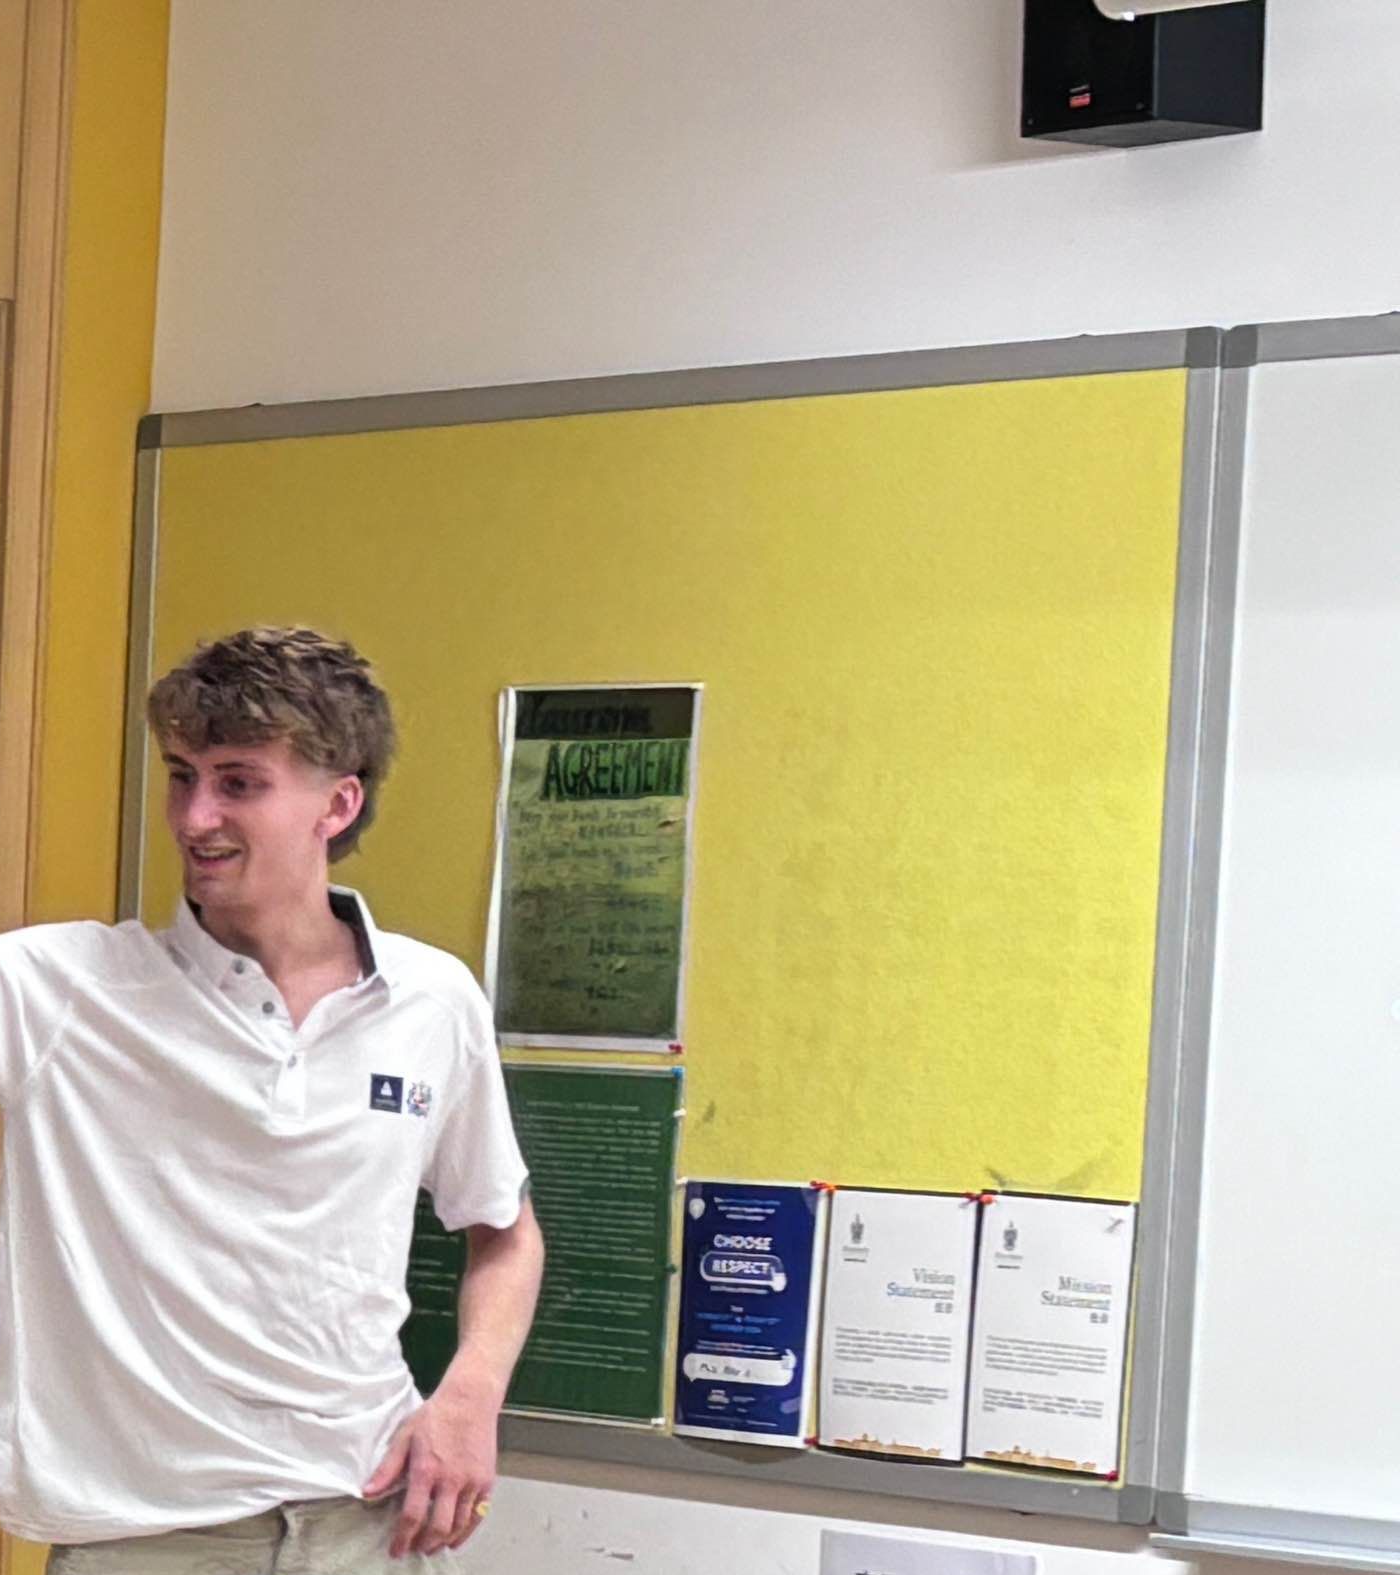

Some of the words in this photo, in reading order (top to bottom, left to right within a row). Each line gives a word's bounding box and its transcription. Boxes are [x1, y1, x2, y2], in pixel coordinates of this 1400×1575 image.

[713, 1234, 773, 1251] CHOOSE
[711, 1259, 771, 1275] RESPECT
[911, 1267, 956, 1285] Vision
[886, 1281, 955, 1301] Statement
[1058, 1275, 1112, 1295] Mission
[1040, 1290, 1111, 1312] Statement
